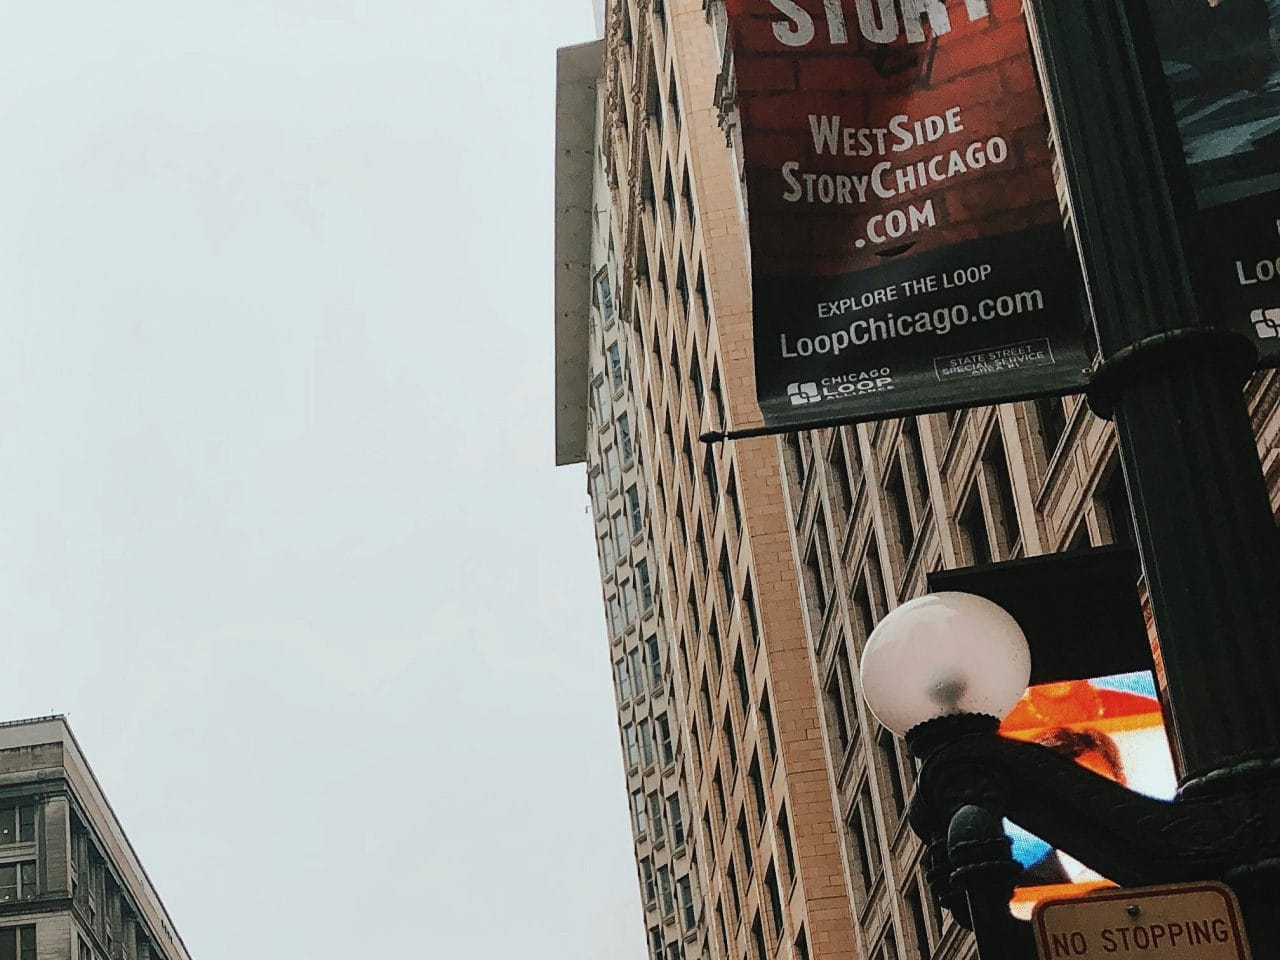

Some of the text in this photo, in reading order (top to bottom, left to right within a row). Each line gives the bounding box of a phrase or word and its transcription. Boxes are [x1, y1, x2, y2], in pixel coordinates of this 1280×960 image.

[817, 264, 992, 319] EXPLORE THE LOOP
[780, 288, 1045, 359] LoopChicago.com
[949, 344, 1033, 367] STATE STREET
[821, 367, 891, 387] CHICAGO
[822, 376, 893, 396] LOOP
[1052, 919, 1229, 957] NO STOPPING
